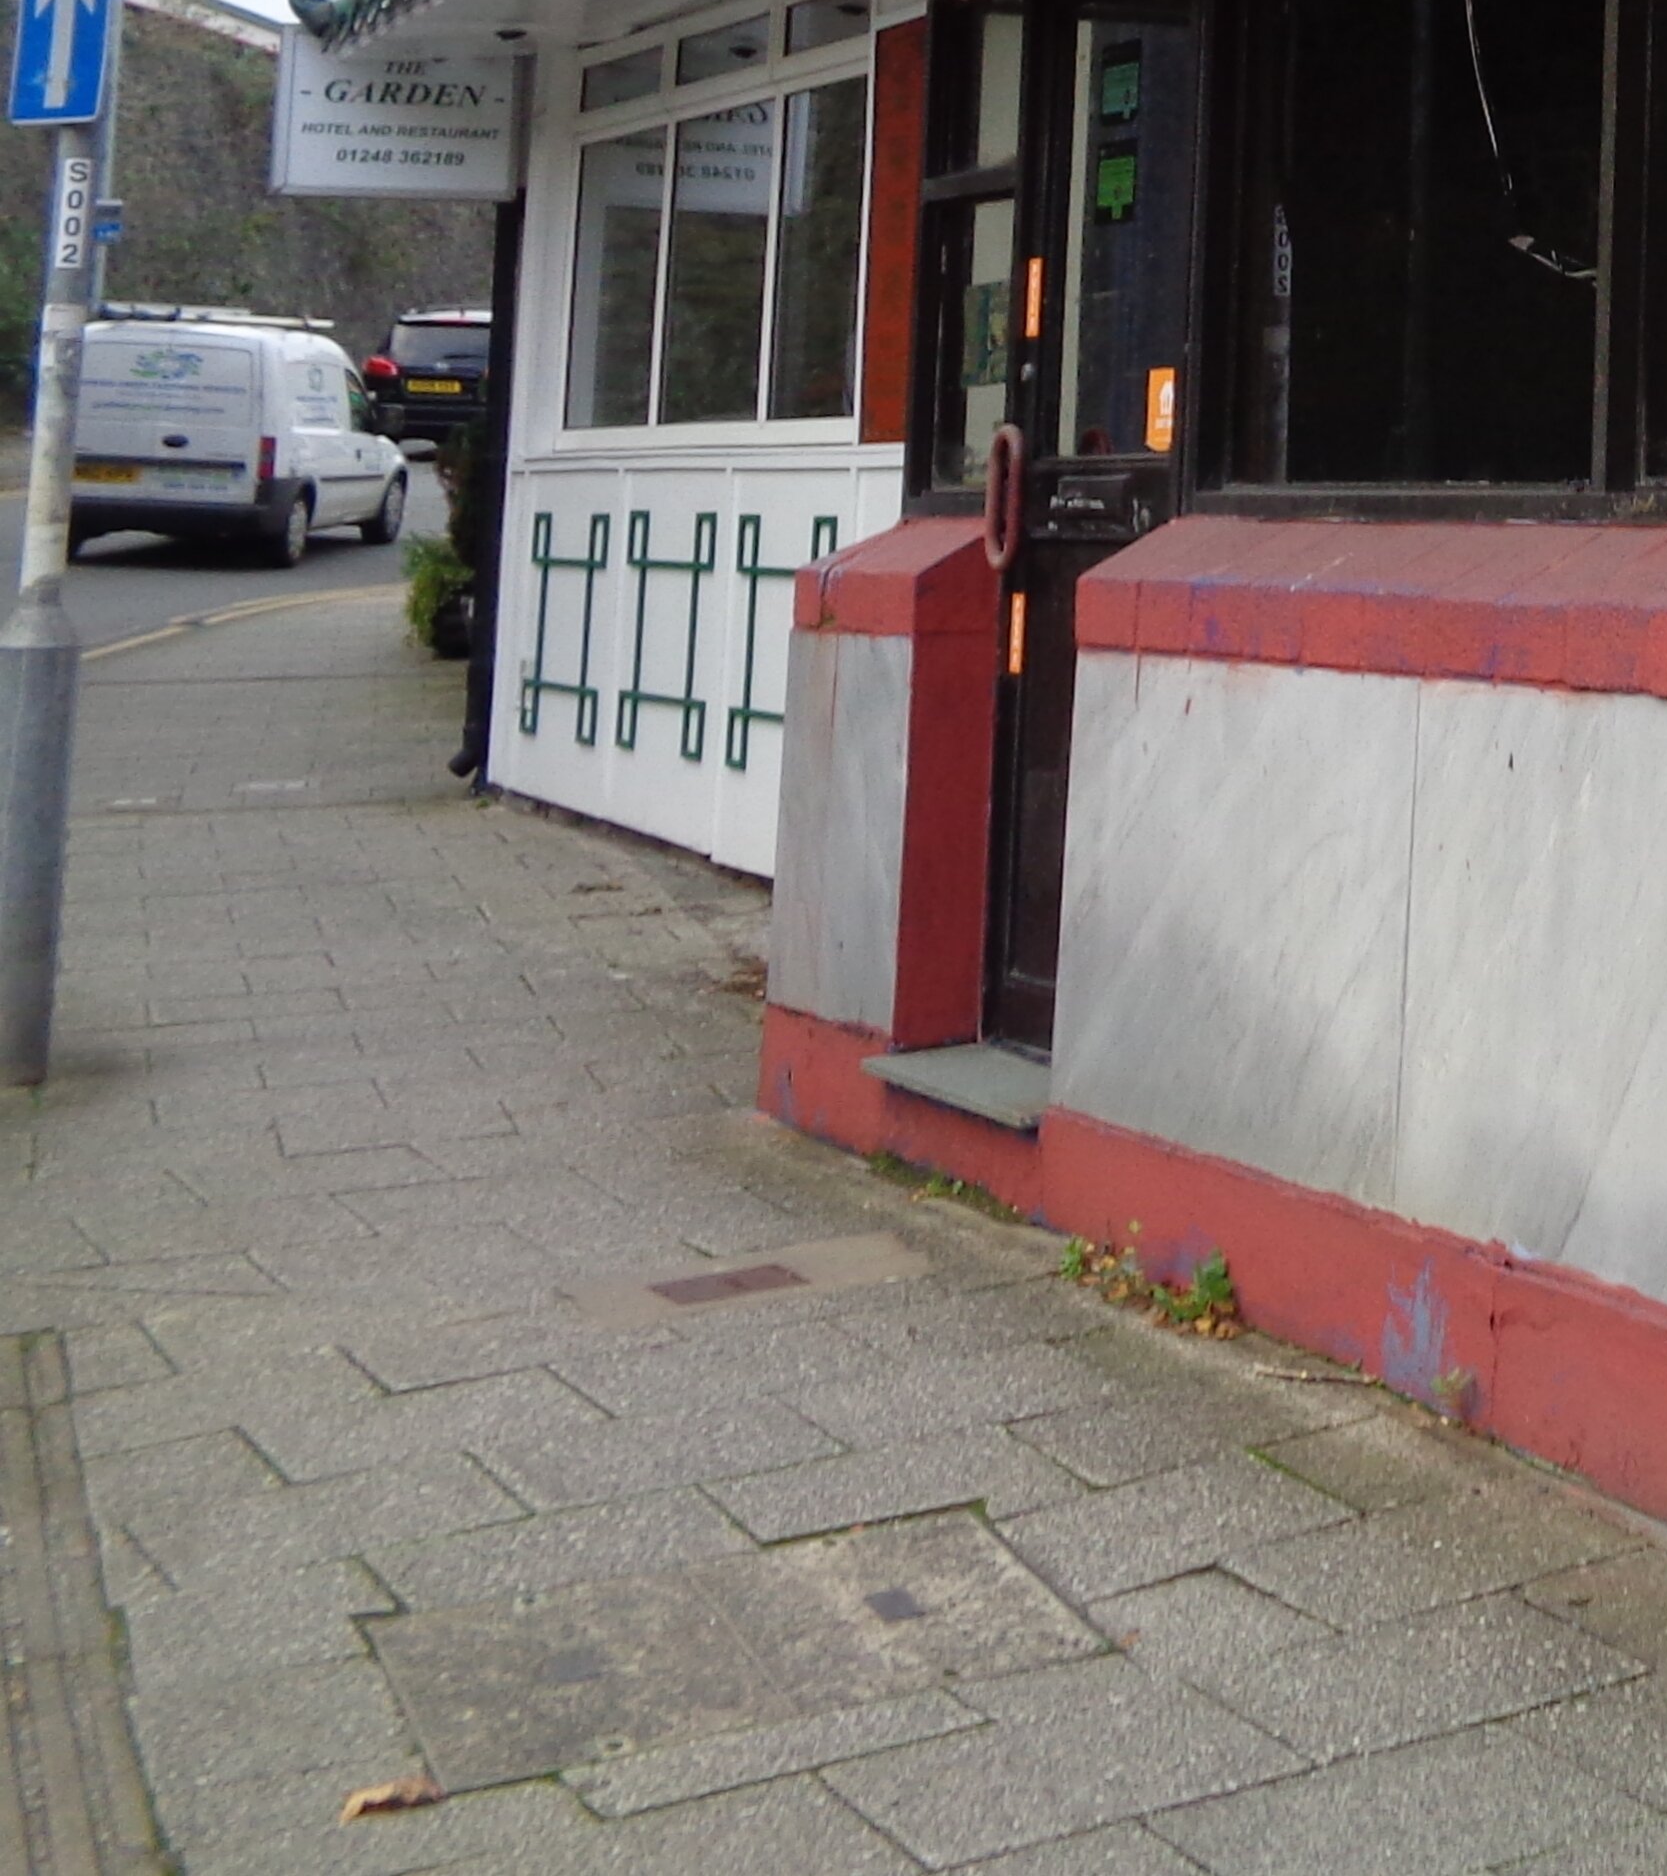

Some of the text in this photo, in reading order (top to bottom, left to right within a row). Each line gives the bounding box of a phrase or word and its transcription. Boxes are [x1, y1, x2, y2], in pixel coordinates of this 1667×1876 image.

[383, 60, 427, 75] THE
[324, 78, 486, 108] GARDEN
[301, 122, 500, 141] HOTEL AND RESTAURANT
[336, 148, 466, 166] 01248 362189
[62, 161, 89, 265] S002
